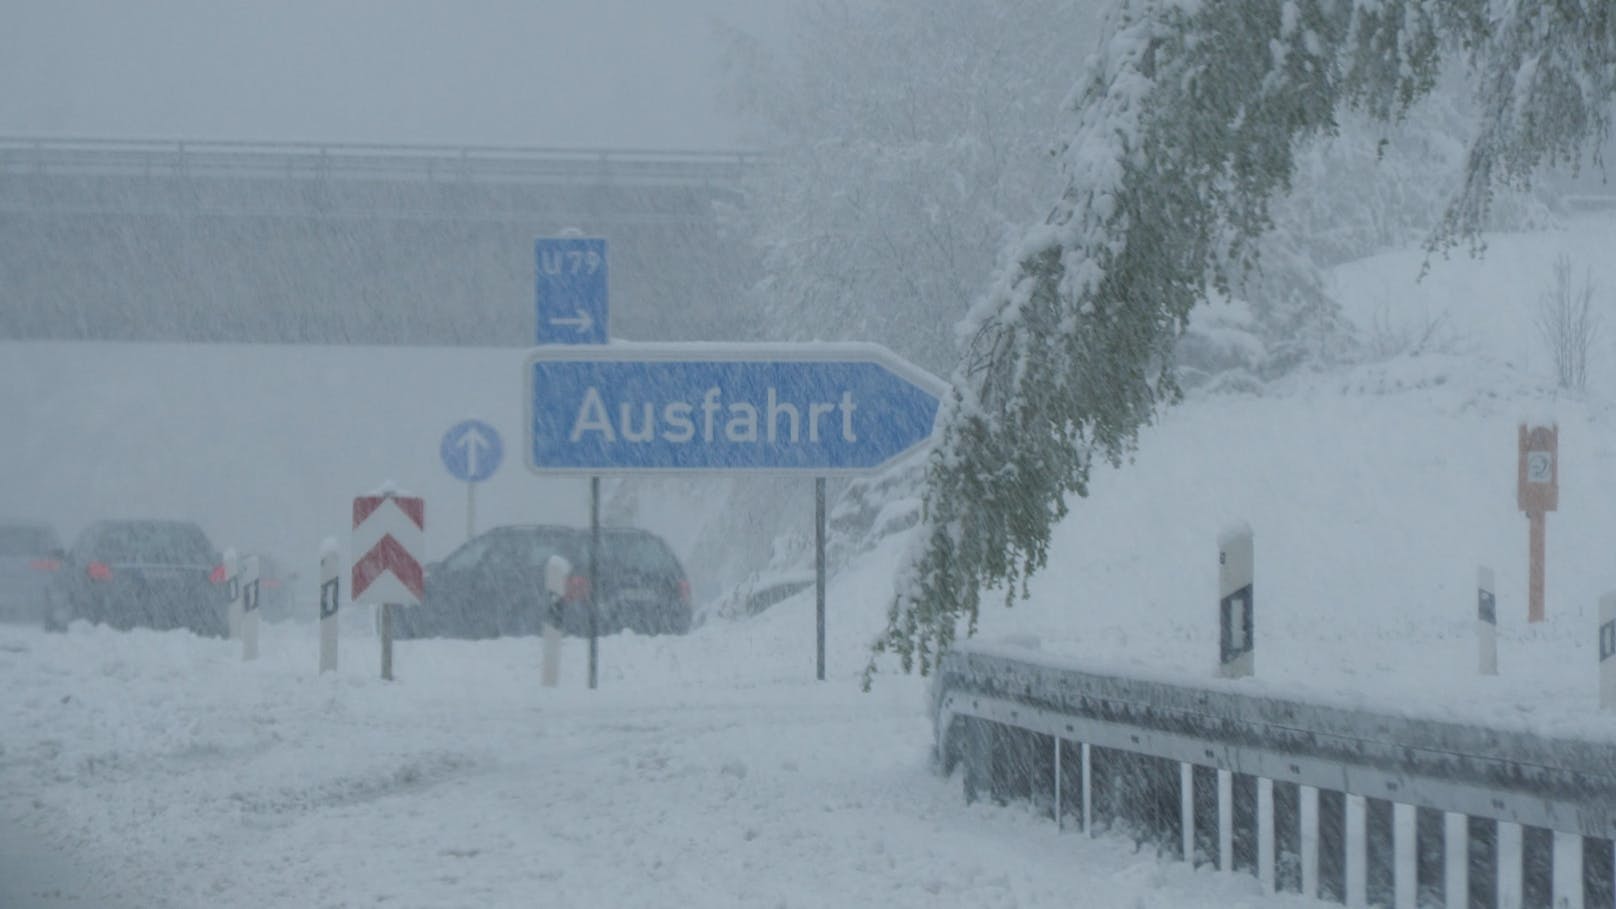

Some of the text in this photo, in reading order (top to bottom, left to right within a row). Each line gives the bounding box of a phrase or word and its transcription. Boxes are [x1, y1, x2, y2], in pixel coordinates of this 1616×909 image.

[542, 250, 600, 274] U 79
[570, 386, 858, 443] Ausfahrt
